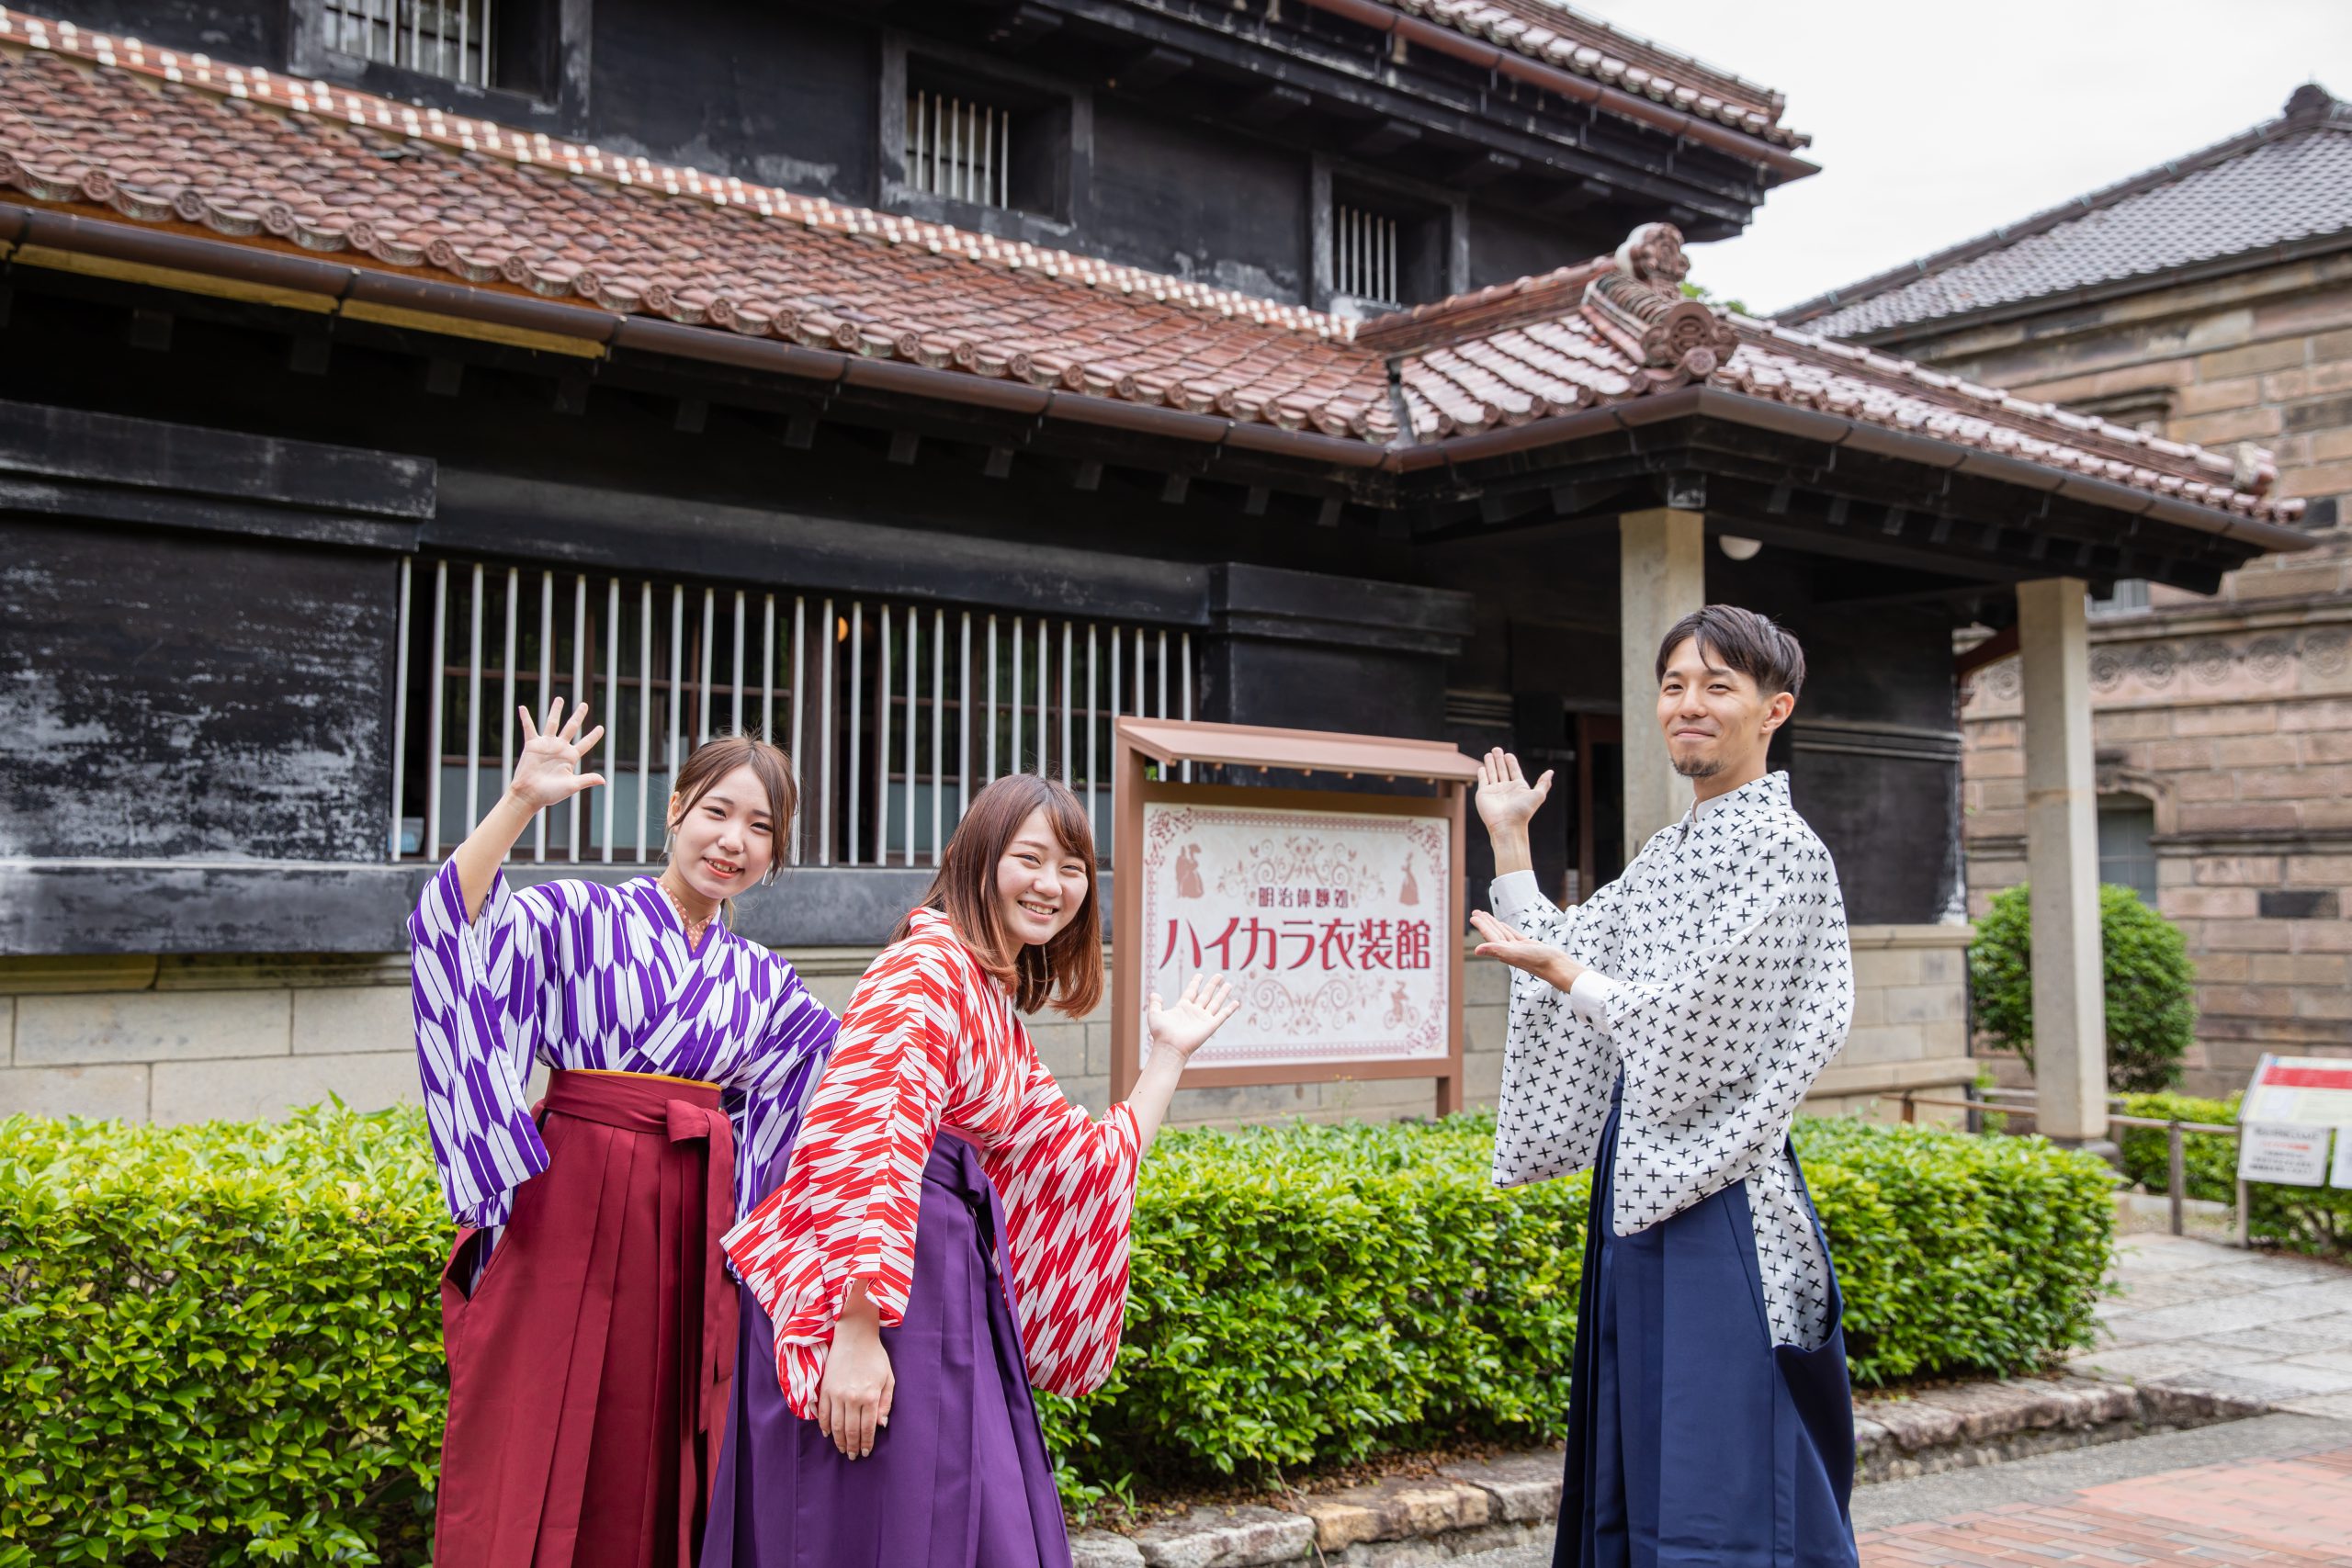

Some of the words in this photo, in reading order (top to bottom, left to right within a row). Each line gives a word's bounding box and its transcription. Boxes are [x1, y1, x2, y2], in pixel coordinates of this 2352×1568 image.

[1159, 917, 1430, 970] ハイカラ衣装館
